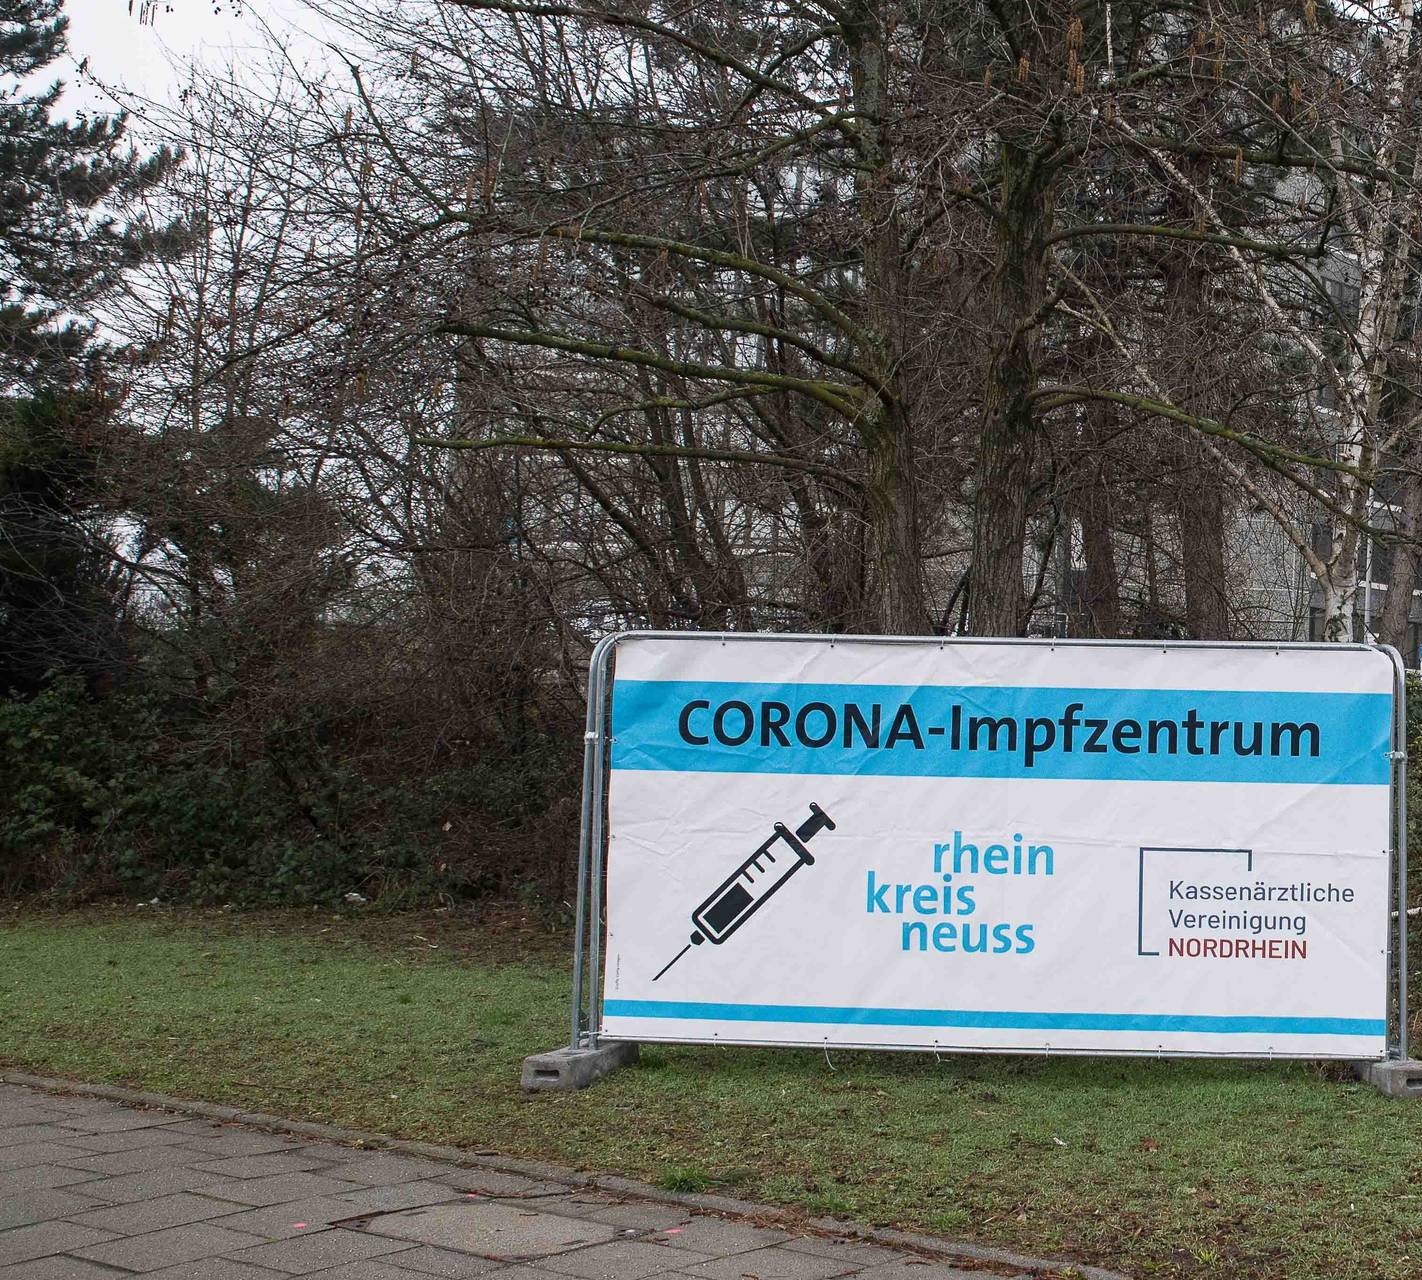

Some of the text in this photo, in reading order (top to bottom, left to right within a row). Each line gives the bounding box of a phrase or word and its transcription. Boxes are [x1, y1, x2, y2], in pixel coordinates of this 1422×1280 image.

[678, 700, 1321, 768] CORONA-Impfzentrum
[933, 830, 1055, 876] rhein
[866, 871, 976, 916] kreis
[1168, 879, 1356, 904] Kassenärztliche
[901, 921, 1036, 955] neuss
[1168, 909, 1307, 936] Vereinigung
[1168, 938, 1308, 960] NORDRHEIN
